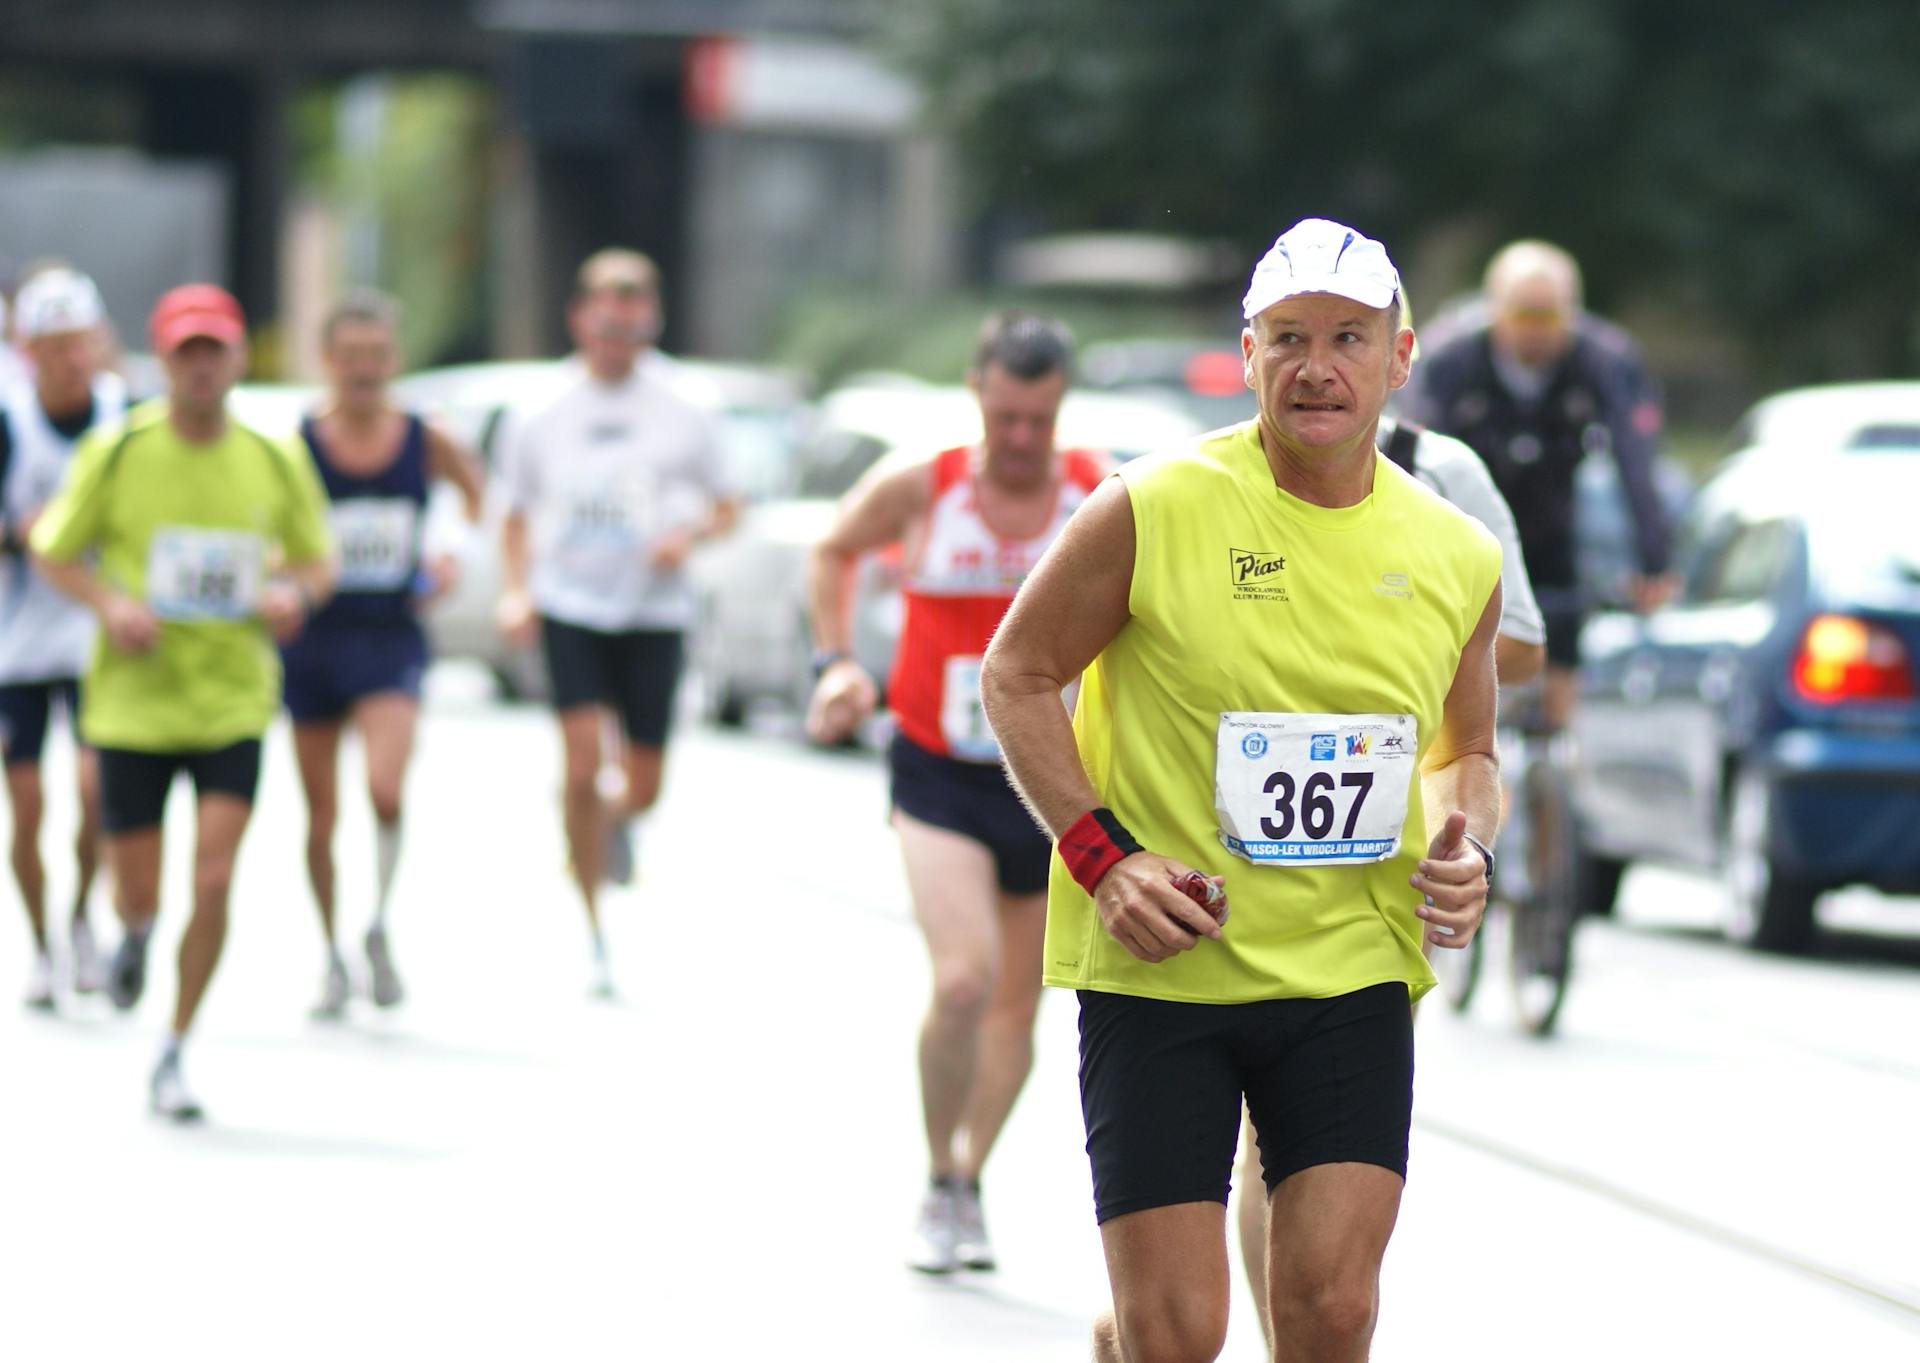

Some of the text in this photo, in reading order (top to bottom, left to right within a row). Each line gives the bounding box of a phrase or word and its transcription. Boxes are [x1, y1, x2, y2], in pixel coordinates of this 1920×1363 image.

[1235, 554, 1286, 582] Piast
[1260, 771, 1374, 840] 367
[1245, 843, 1301, 856] HASCO-LEK
[1303, 843, 1351, 855] WROCŁAW
